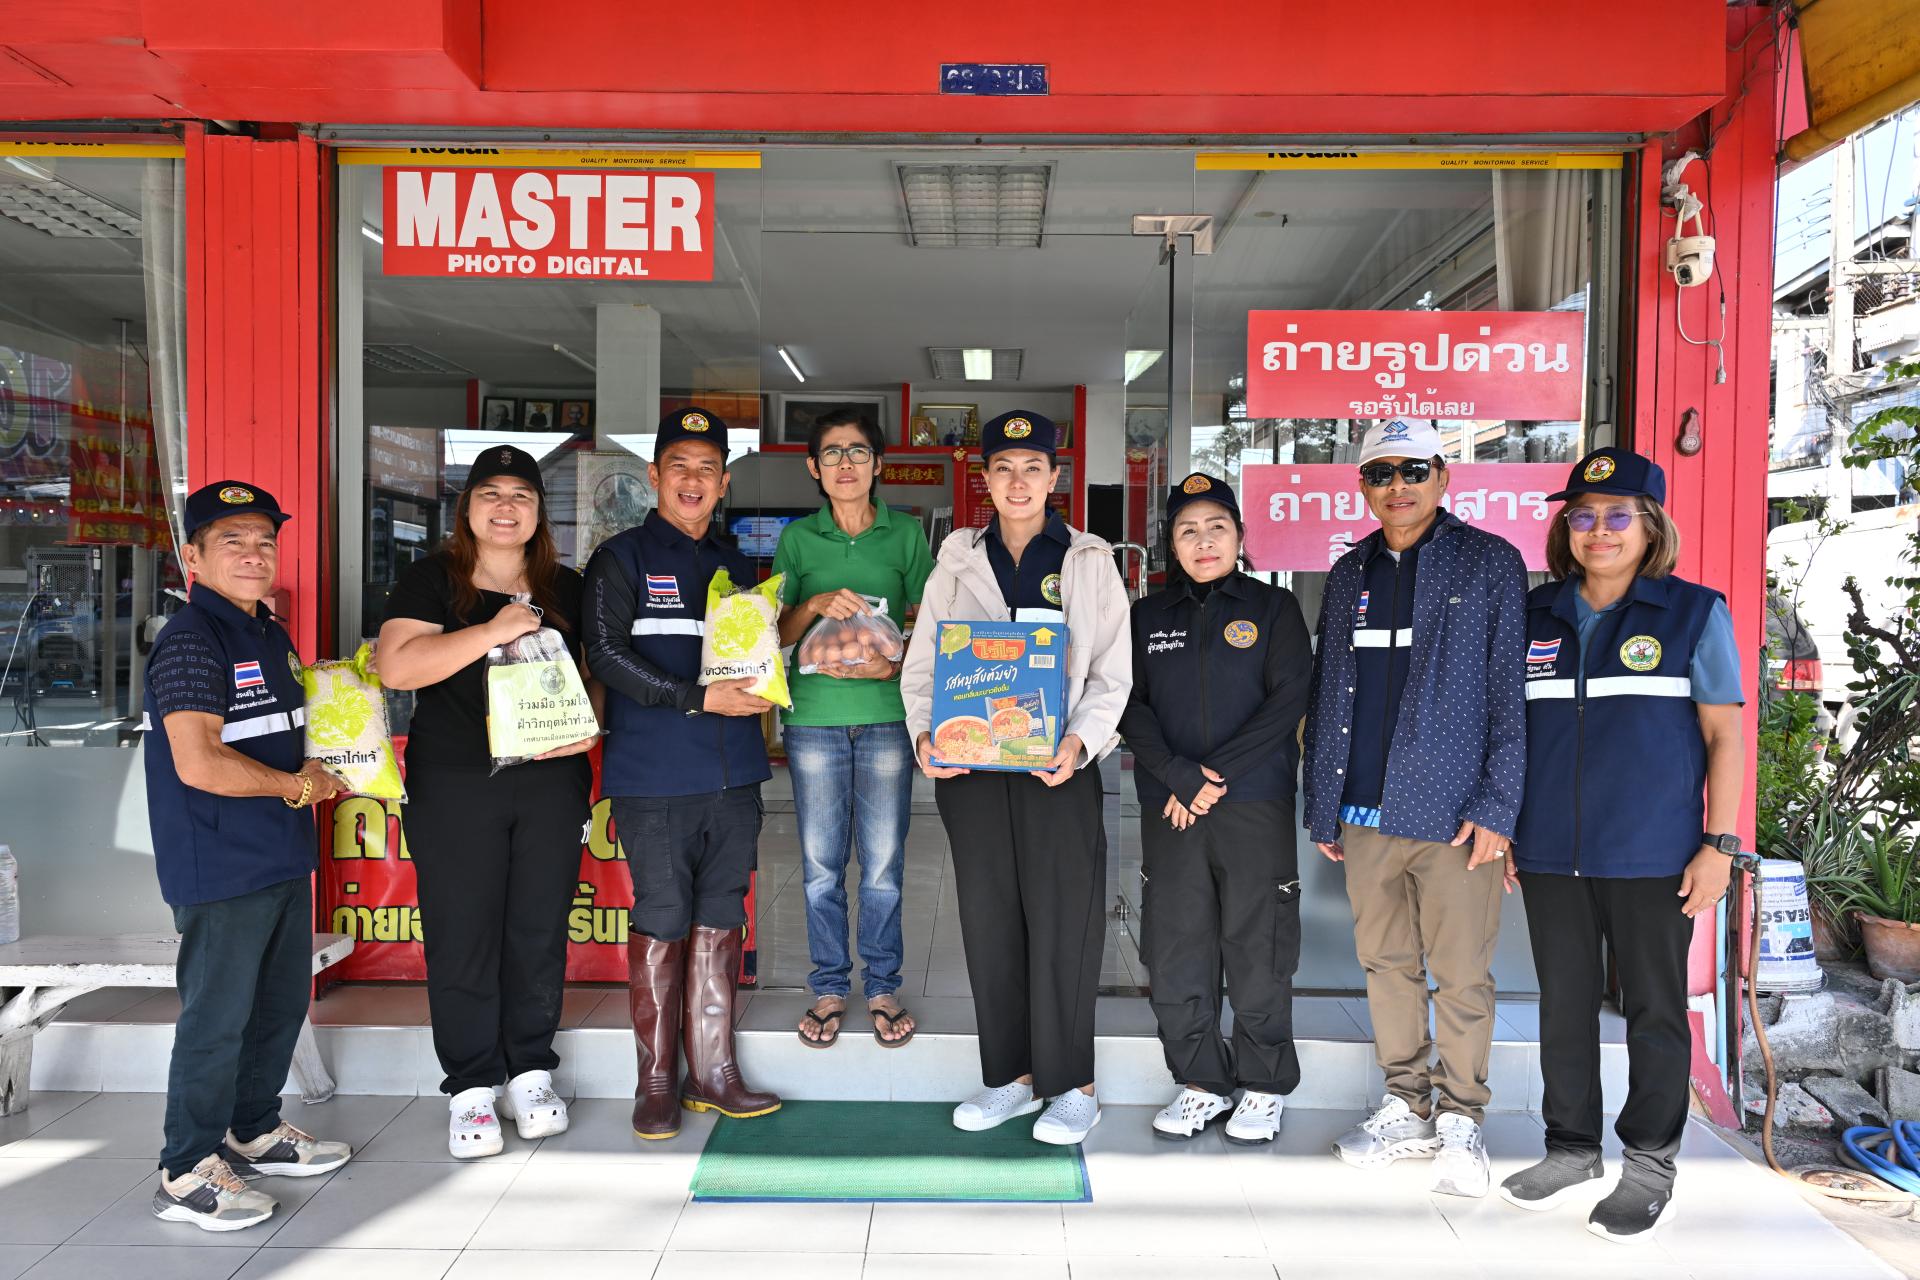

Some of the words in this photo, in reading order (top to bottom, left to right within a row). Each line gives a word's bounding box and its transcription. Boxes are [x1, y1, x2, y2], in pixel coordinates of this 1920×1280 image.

[613, 157, 655, 165] MONITORING
[396, 171, 703, 252] MASTER
[448, 254, 536, 274] PHOTO
[547, 255, 649, 276] DIGITAL
[1262, 324, 1571, 389] ถ่ายรูปด่วน
[1348, 388, 1475, 417] รอรับได้เลย
[190, 680, 210, 689] you
[517, 696, 556, 711] ร่วมมือ
[558, 692, 589, 708] ร่วมใจ
[517, 711, 596, 731] ฝ่าวิกฤตน้ำท่วม
